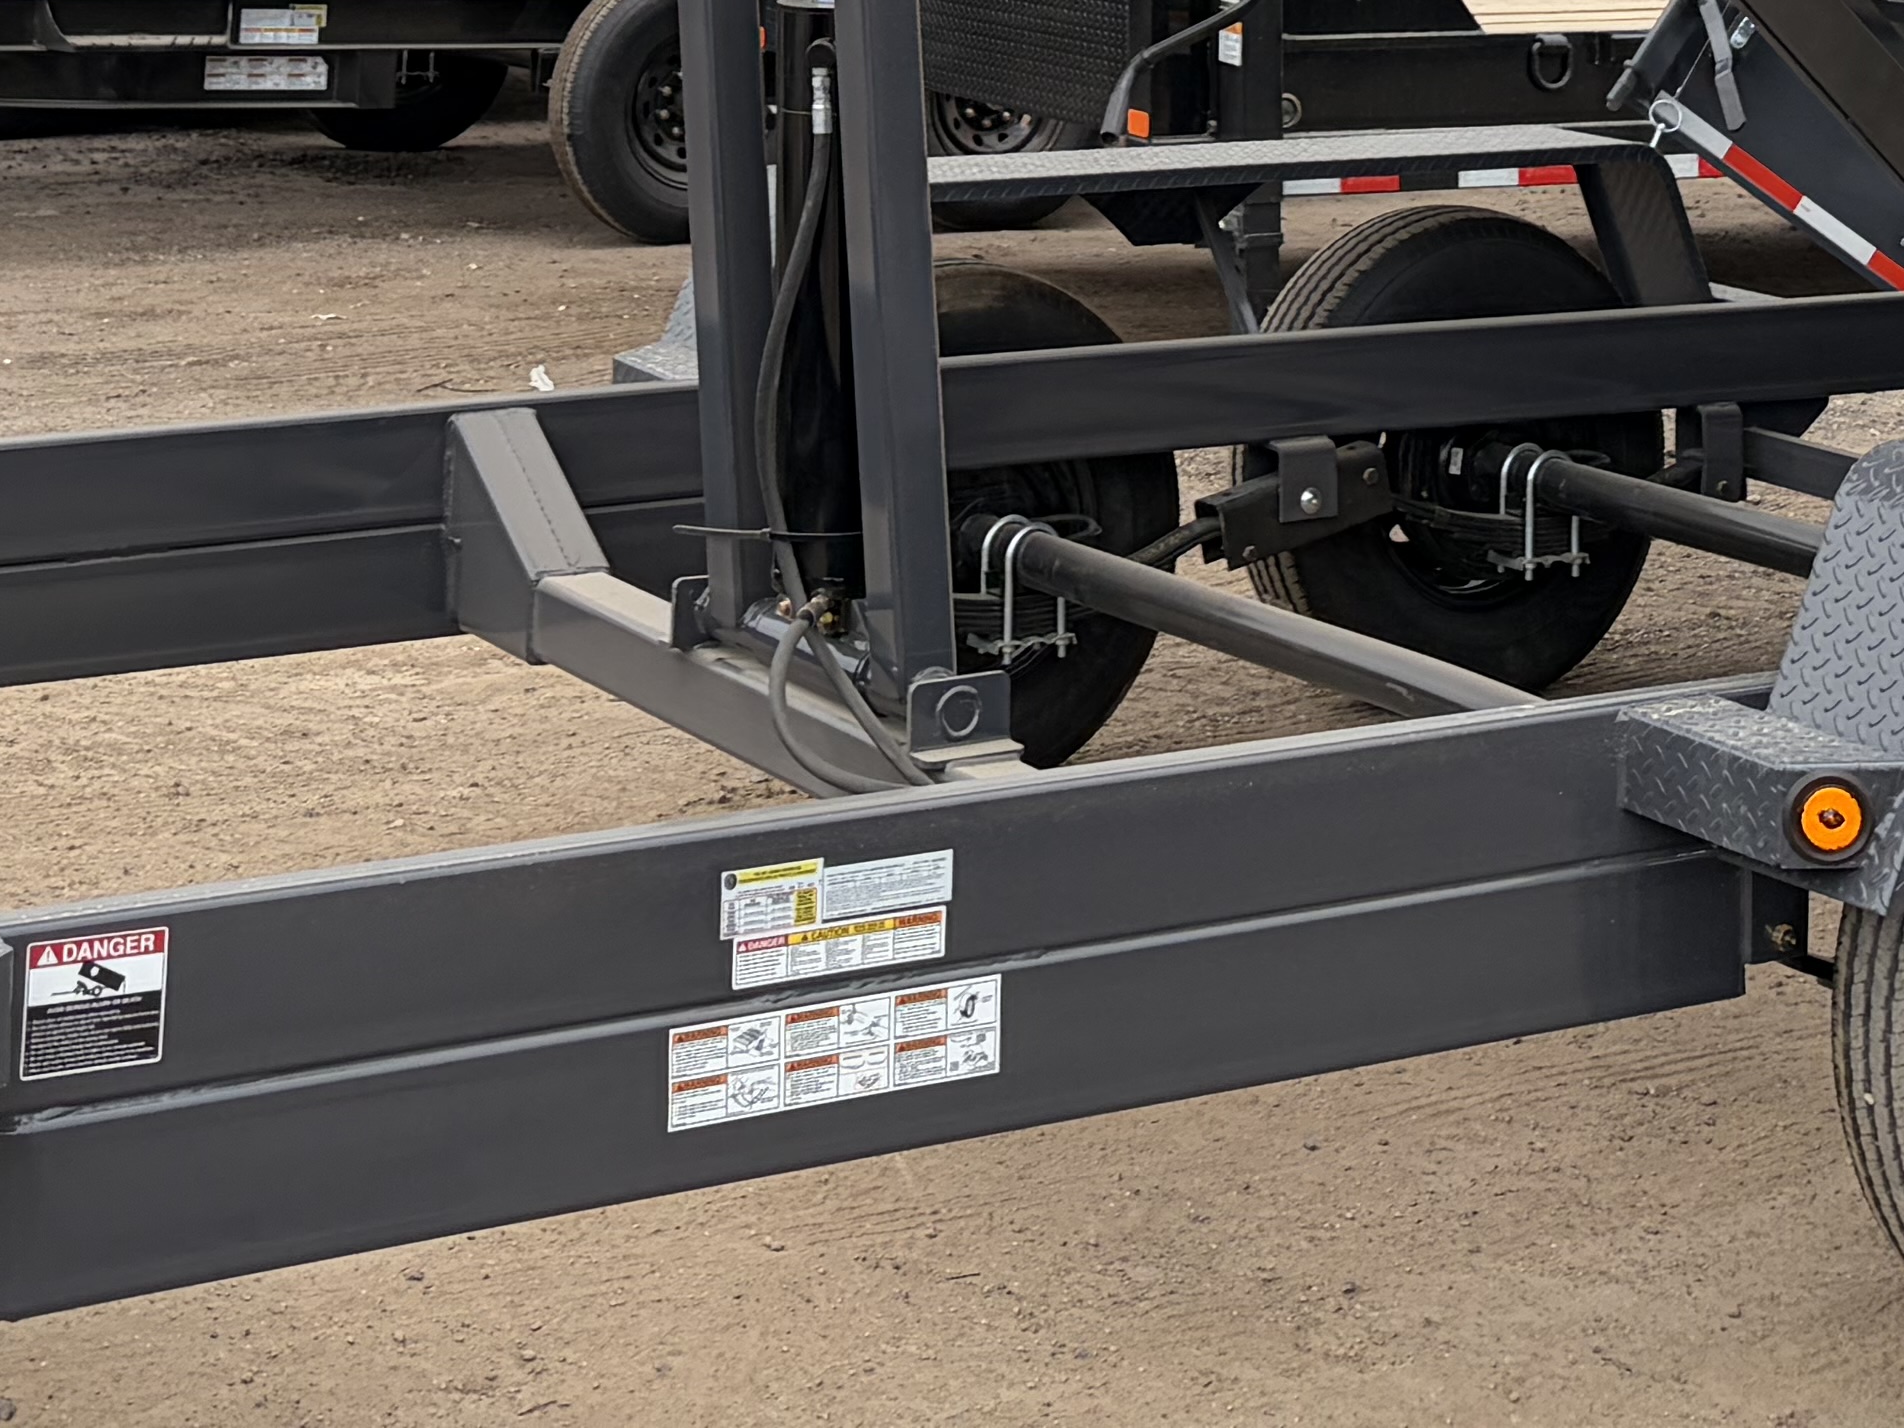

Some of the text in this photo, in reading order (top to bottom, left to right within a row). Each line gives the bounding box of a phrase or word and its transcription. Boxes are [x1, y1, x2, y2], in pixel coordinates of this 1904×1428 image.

[810, 927, 850, 941] CAUTION
[62, 933, 156, 962] DANGER
[748, 935, 786, 951] DANGER
